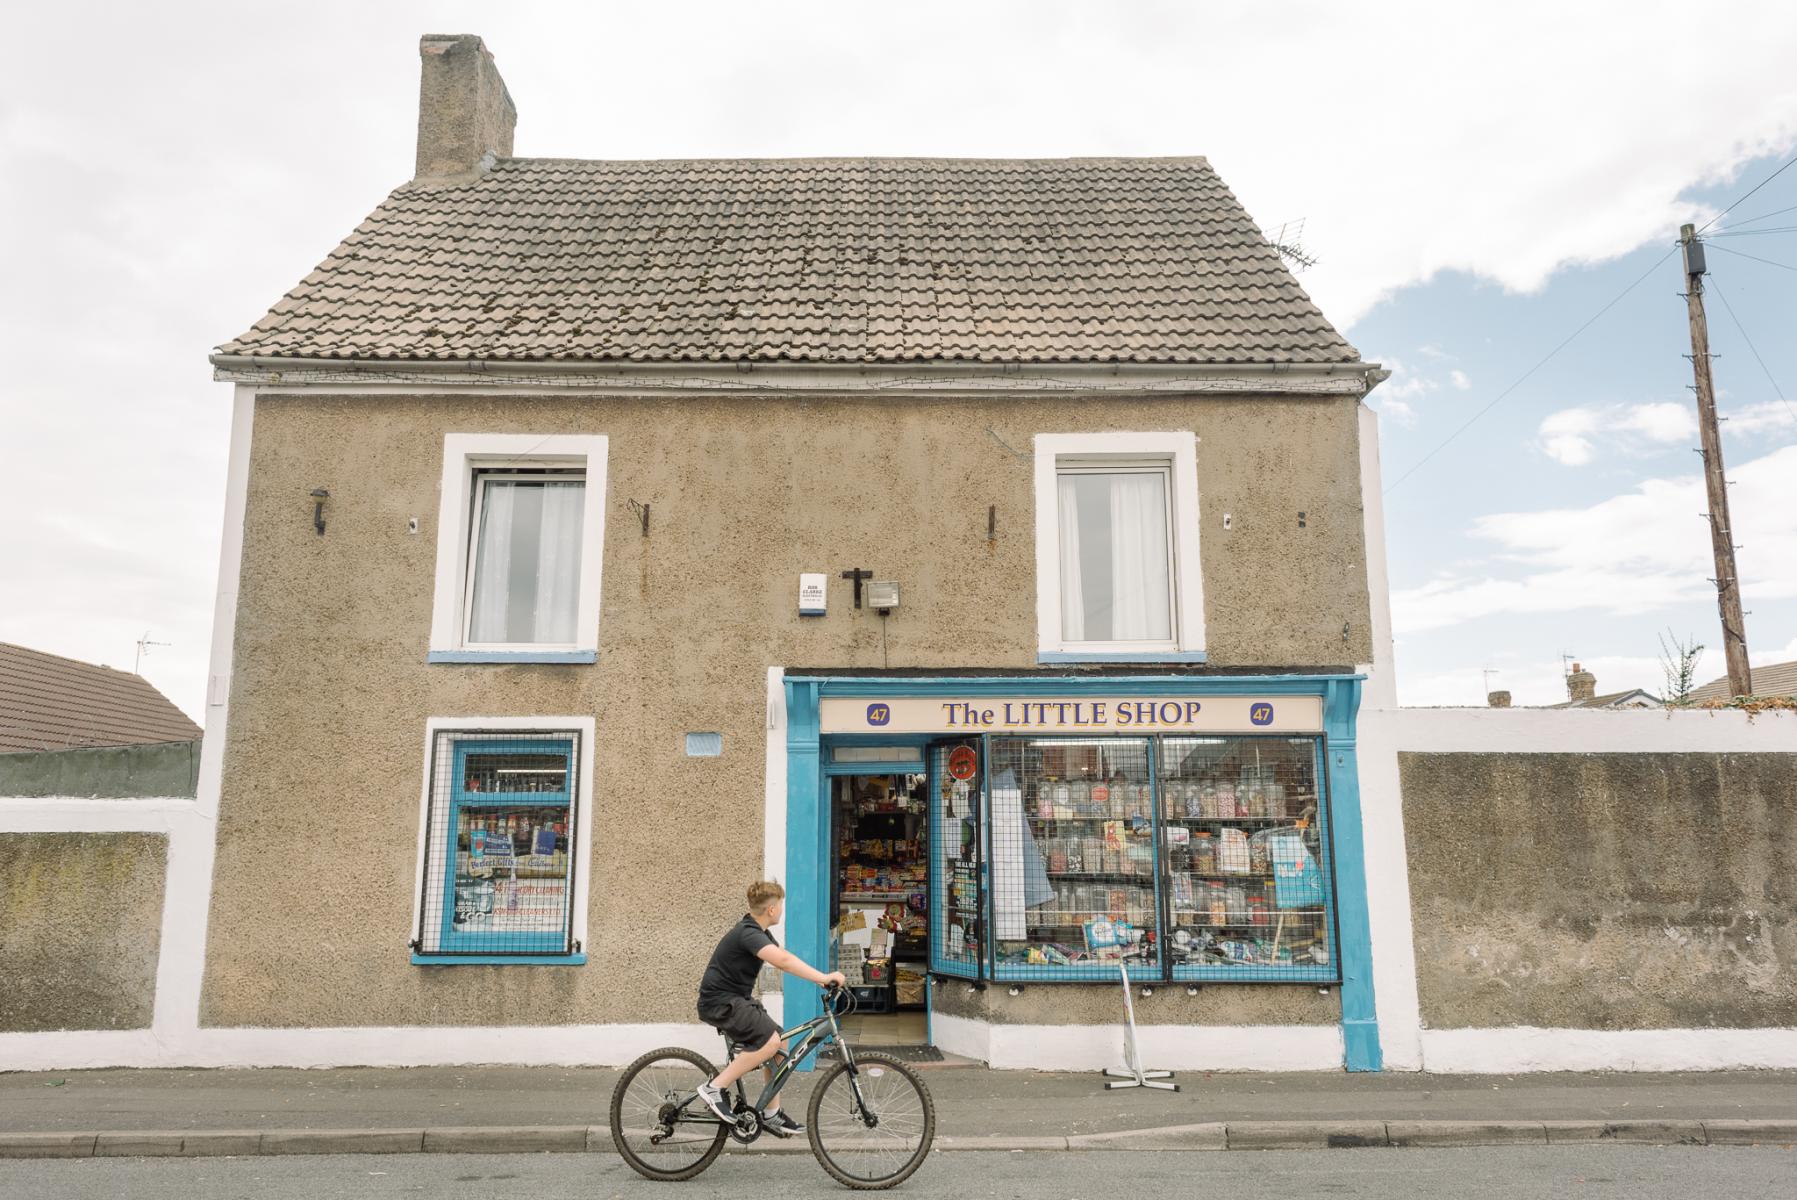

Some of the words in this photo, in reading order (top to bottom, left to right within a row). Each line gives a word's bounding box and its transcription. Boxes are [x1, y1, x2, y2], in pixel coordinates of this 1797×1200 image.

[870, 708, 887, 721] 47
[942, 702, 994, 726] The
[1002, 702, 1107, 726] LITTLE
[1115, 701, 1201, 726] SHOP
[1252, 707, 1270, 721] 47
